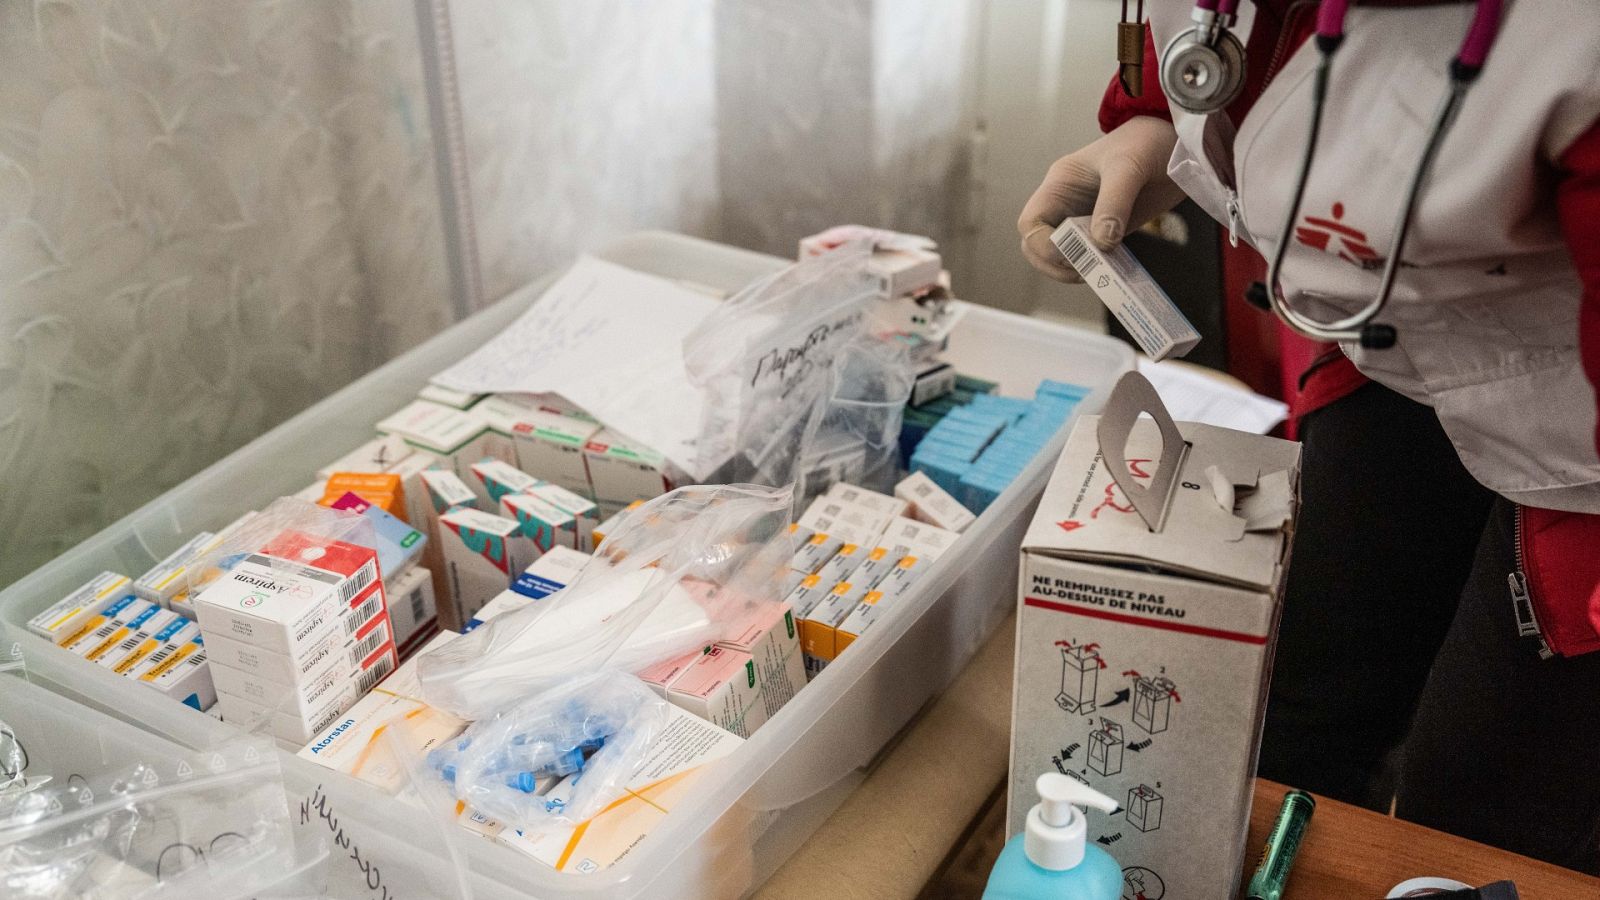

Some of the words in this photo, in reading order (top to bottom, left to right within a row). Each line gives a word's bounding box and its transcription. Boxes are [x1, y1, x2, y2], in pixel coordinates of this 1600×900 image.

[233, 574, 289, 594] Aspirem
[1032, 575, 1051, 586] NE
[1055, 579, 1134, 600] REMPLISSEZ
[1138, 593, 1165, 605] PAS
[1032, 586, 1105, 606] AU-DESSUS
[1109, 599, 1127, 610] DE
[1131, 602, 1185, 618] NIVEAU
[296, 617, 323, 642] Aspirem
[302, 647, 329, 673] Aspirem
[307, 679, 334, 704] Aspirem
[313, 707, 340, 734] Aspirem
[311, 719, 356, 754] Atorstan
